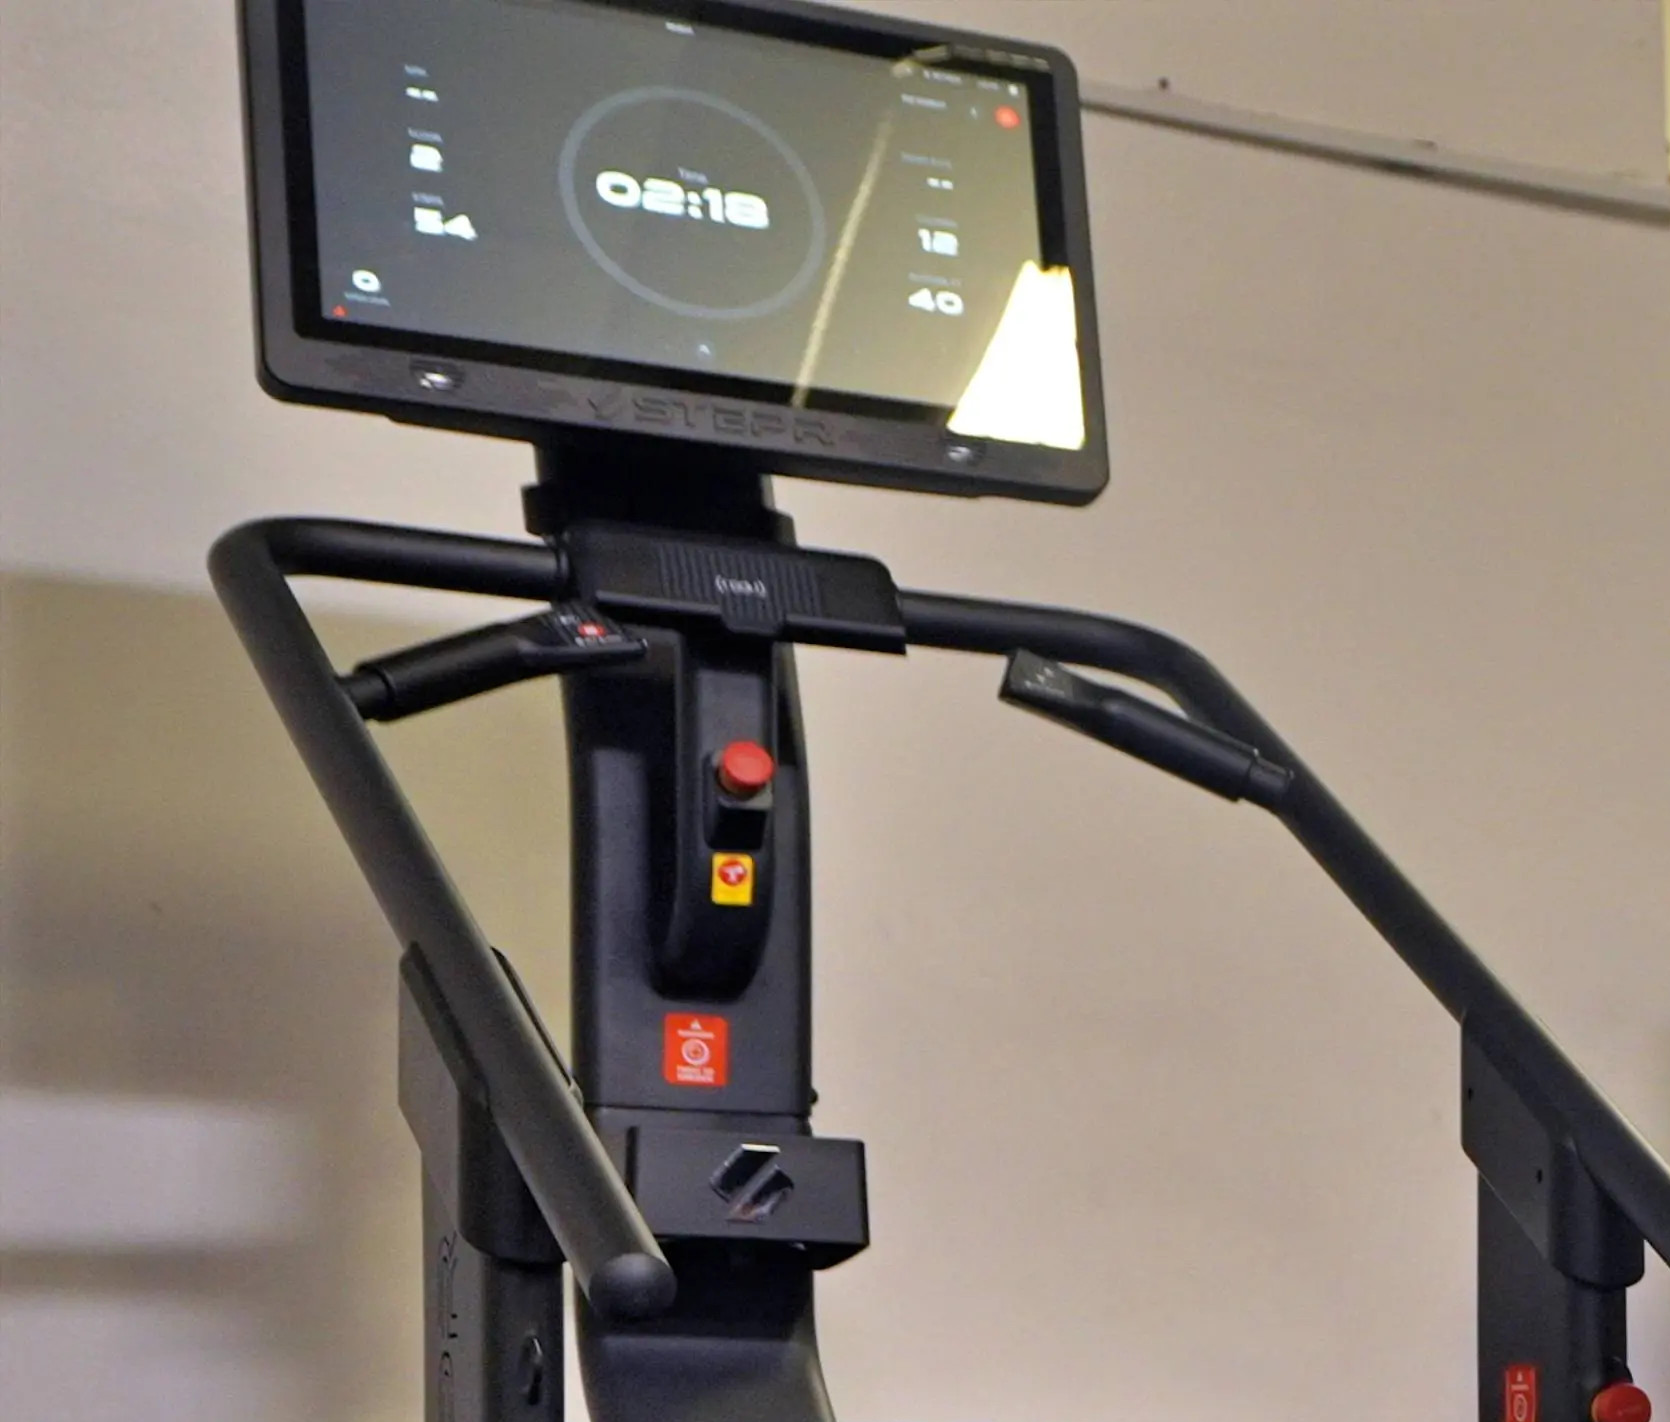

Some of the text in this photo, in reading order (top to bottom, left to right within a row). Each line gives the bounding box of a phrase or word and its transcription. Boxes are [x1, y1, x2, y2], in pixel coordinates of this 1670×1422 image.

[595, 169, 770, 230] 02:18
[352, 269, 382, 293] 0
[908, 287, 964, 316] 40
[634, 396, 836, 447] STEPR
